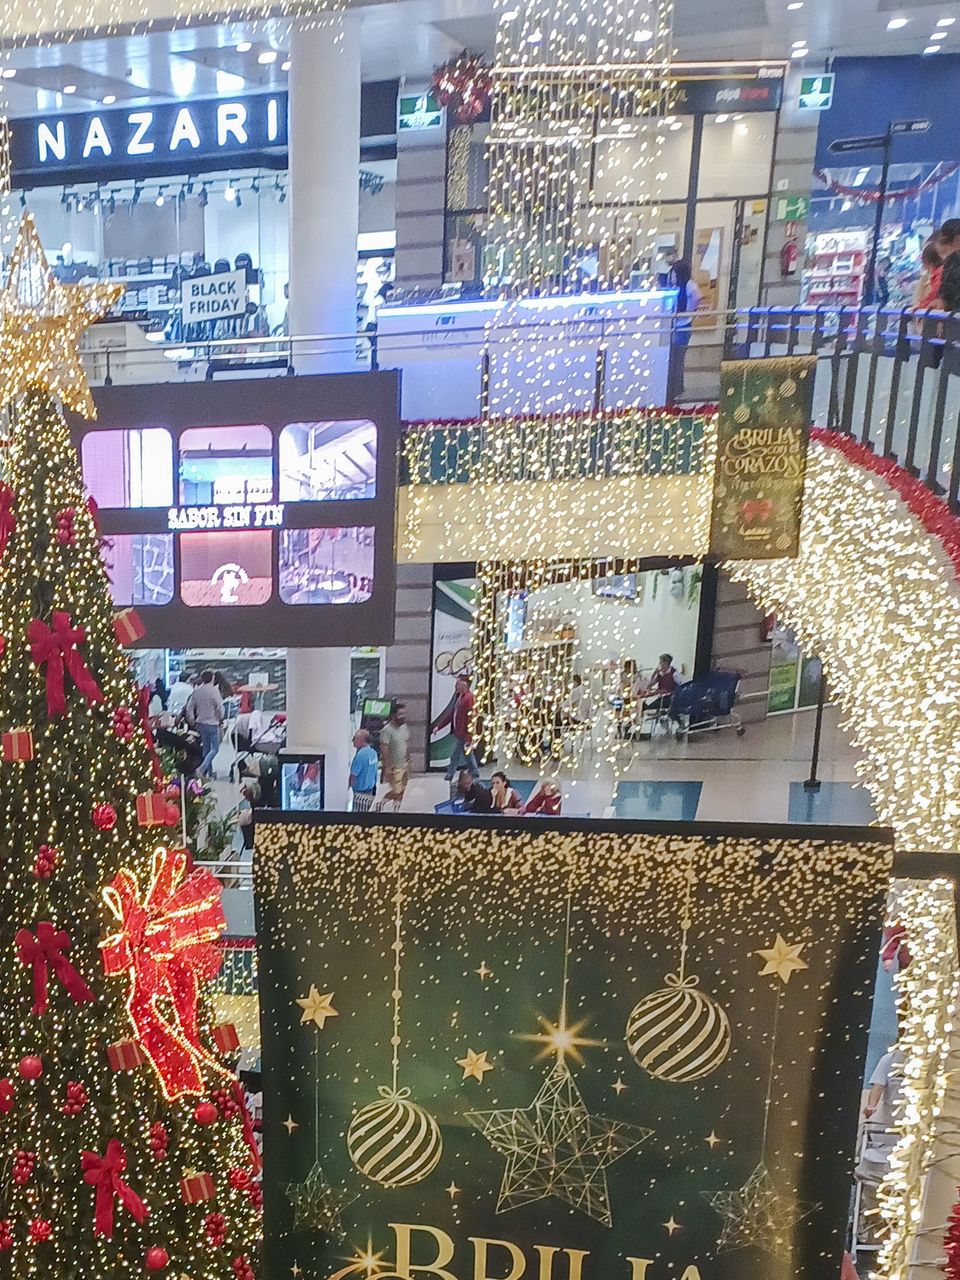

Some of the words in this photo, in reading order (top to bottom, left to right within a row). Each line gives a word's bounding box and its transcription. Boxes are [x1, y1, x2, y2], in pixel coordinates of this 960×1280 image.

[37, 99, 277, 162] NAZARI
[191, 280, 237, 297] BLACK
[189, 297, 240, 315] FRIDAY
[167, 506, 221, 530] SABOR
[223, 505, 252, 528] SIN
